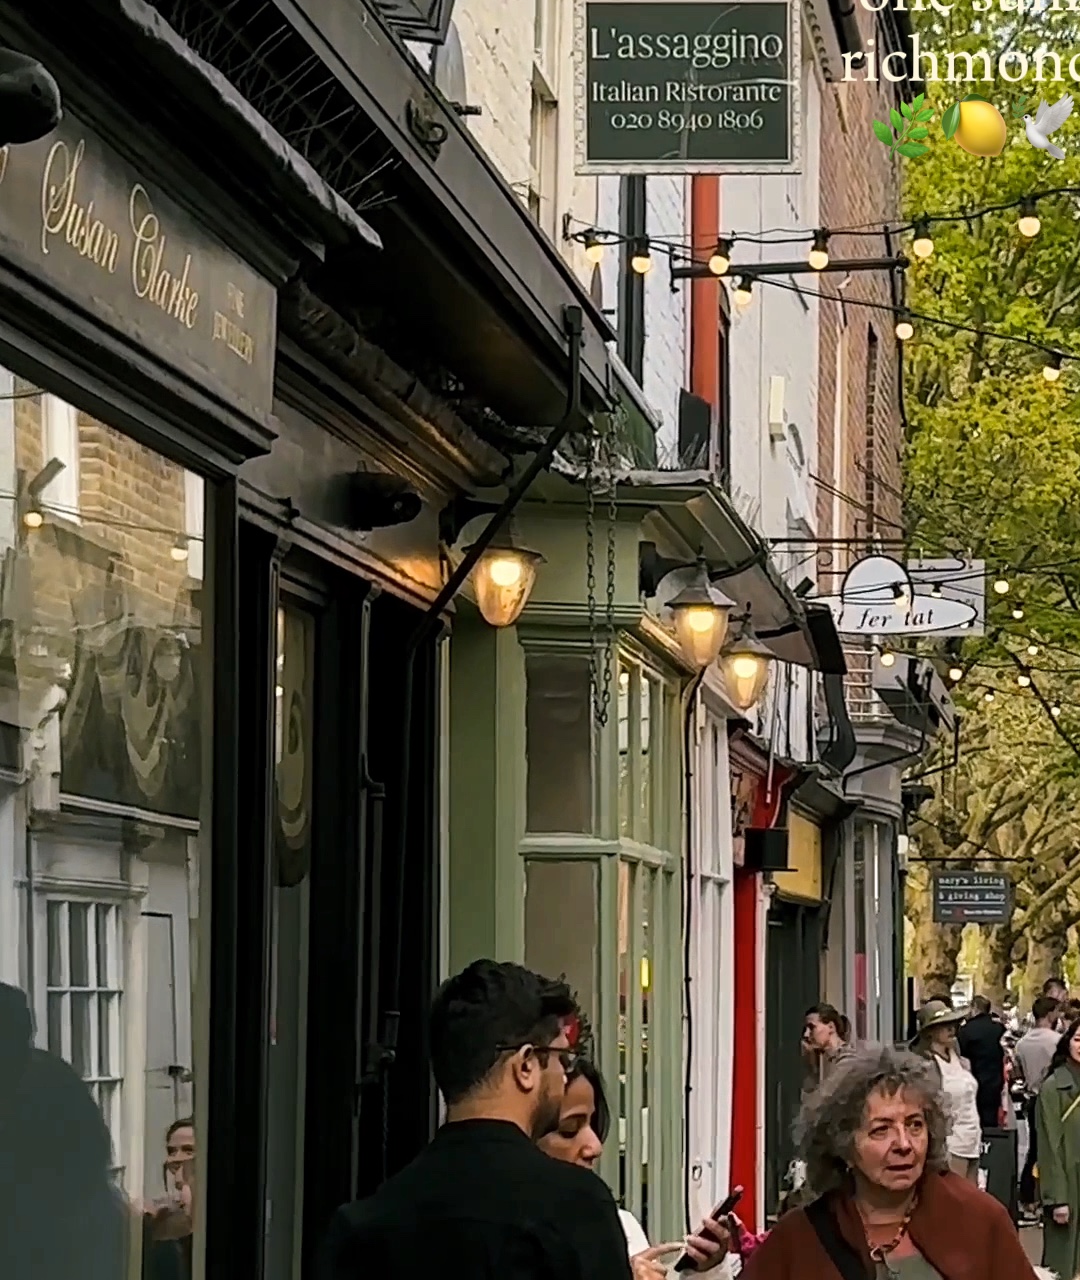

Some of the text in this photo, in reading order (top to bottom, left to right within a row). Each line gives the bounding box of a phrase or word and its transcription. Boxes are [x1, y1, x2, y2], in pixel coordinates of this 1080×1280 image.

[591, 28, 783, 69] L'assaggino
[592, 80, 782, 103] Italian Ristorante
[611, 108, 763, 133] 020 8940 1806
[42, 140, 119, 273] Susan
[857, 608, 893, 630] fer
[904, 608, 934, 627] tat
